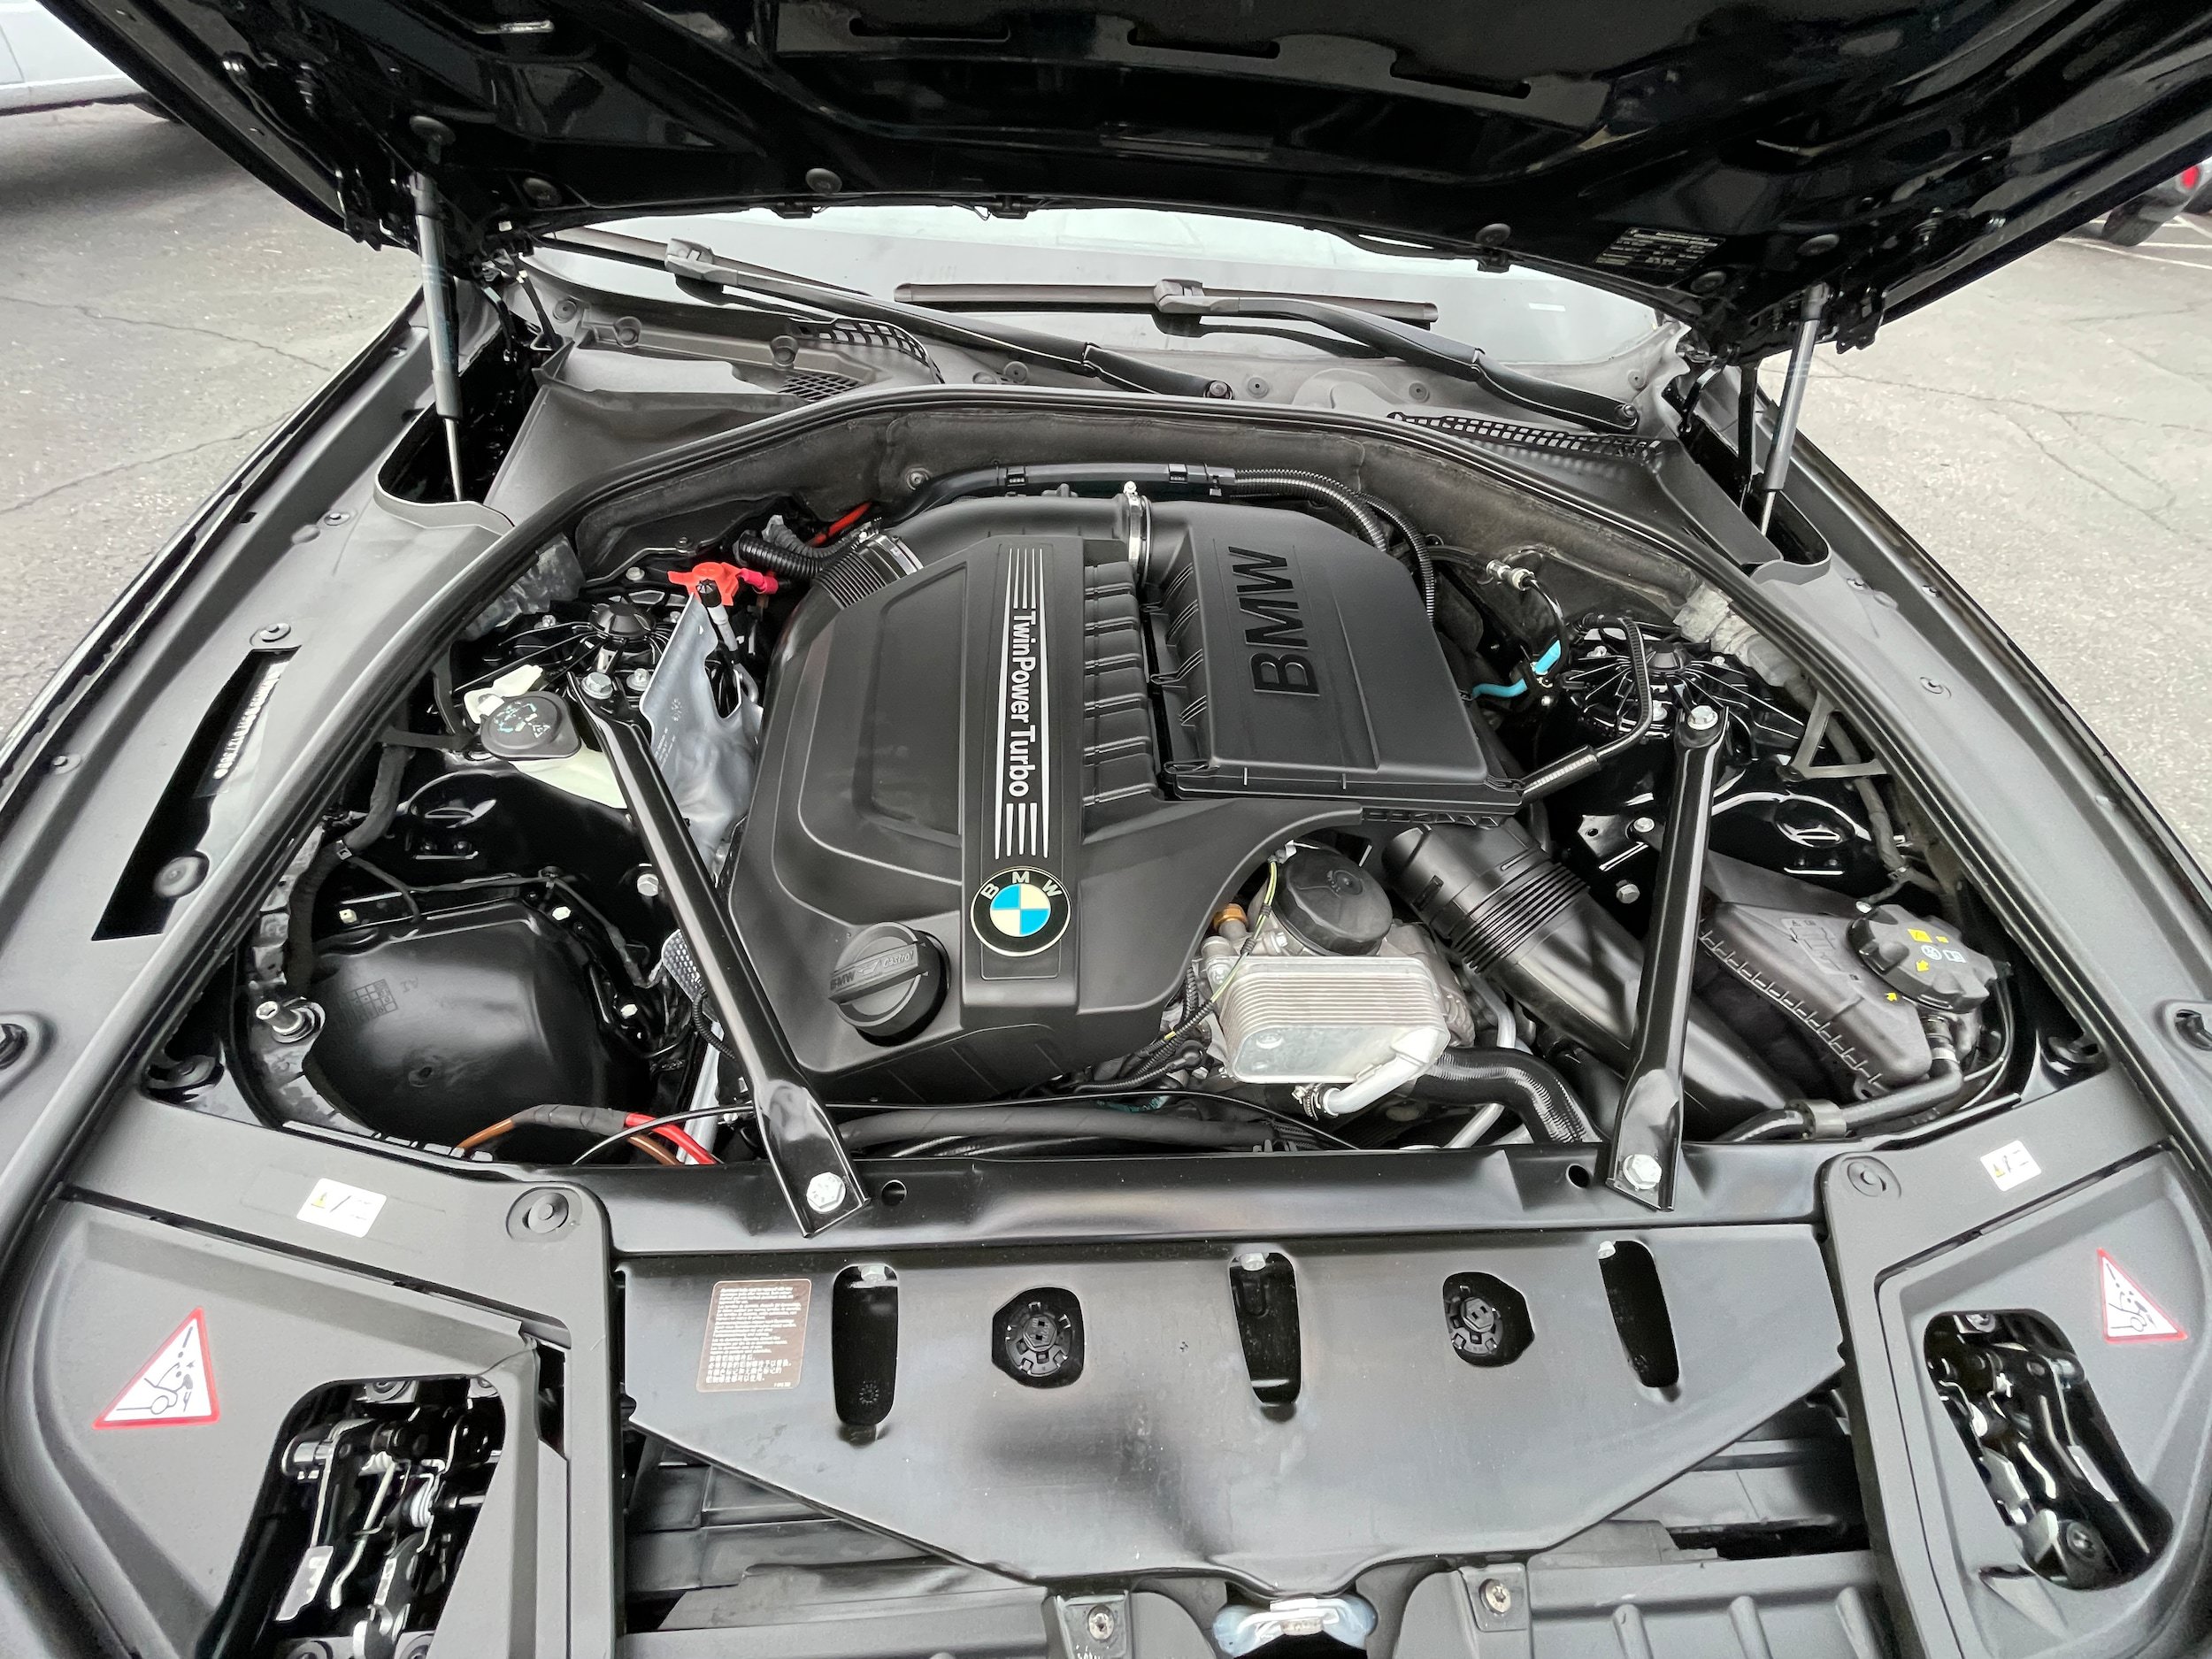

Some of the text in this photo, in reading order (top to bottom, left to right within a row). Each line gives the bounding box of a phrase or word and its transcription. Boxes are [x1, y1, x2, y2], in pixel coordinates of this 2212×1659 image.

[1228, 546, 1320, 696] BMW
[1009, 611, 1036, 797] TwinPower Turbo
[980, 871, 1063, 900] BMW
[830, 950, 914, 990] BMW Castrol
